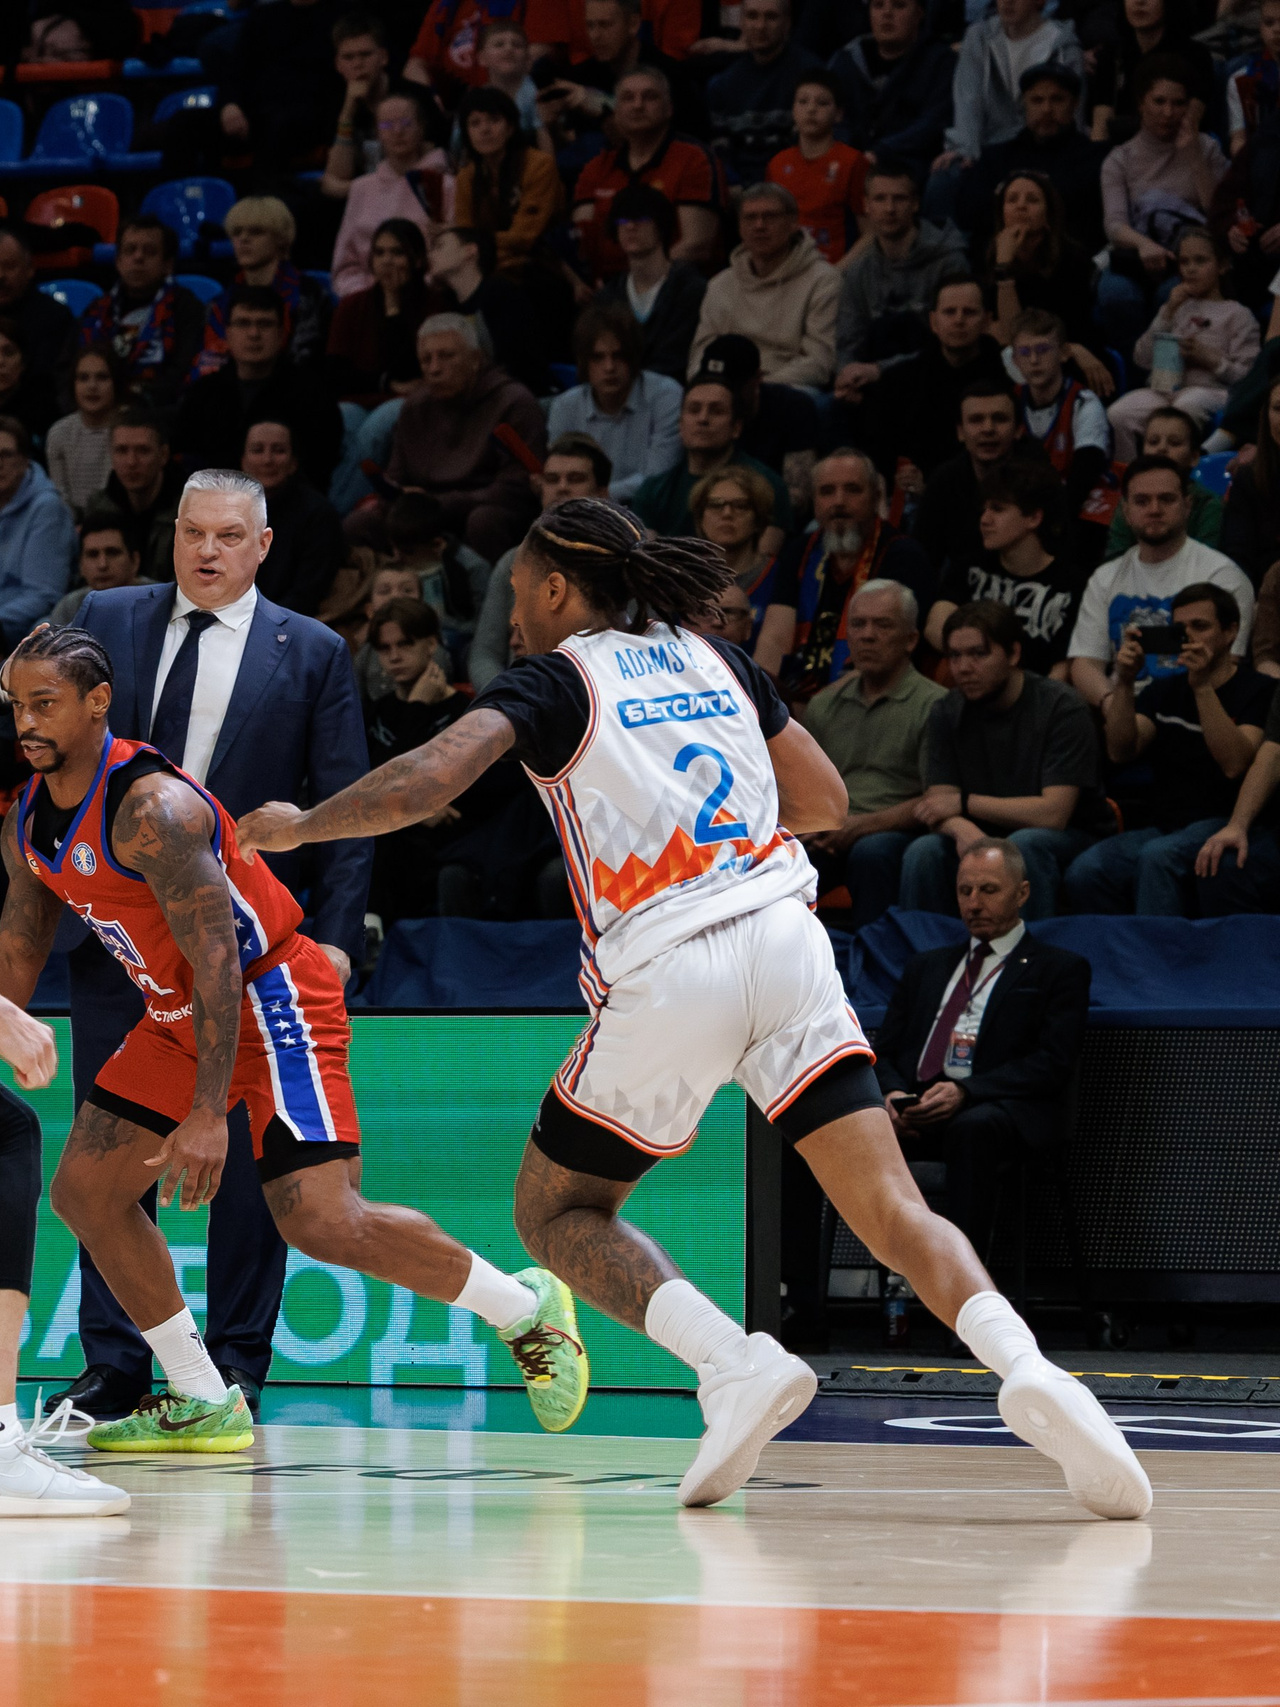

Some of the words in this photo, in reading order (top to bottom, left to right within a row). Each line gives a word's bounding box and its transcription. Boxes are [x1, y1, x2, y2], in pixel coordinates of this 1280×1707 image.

[614, 641, 686, 681] ADAMS
[624, 694, 736, 723] БЕТСИТИ
[672, 742, 750, 847] 2
